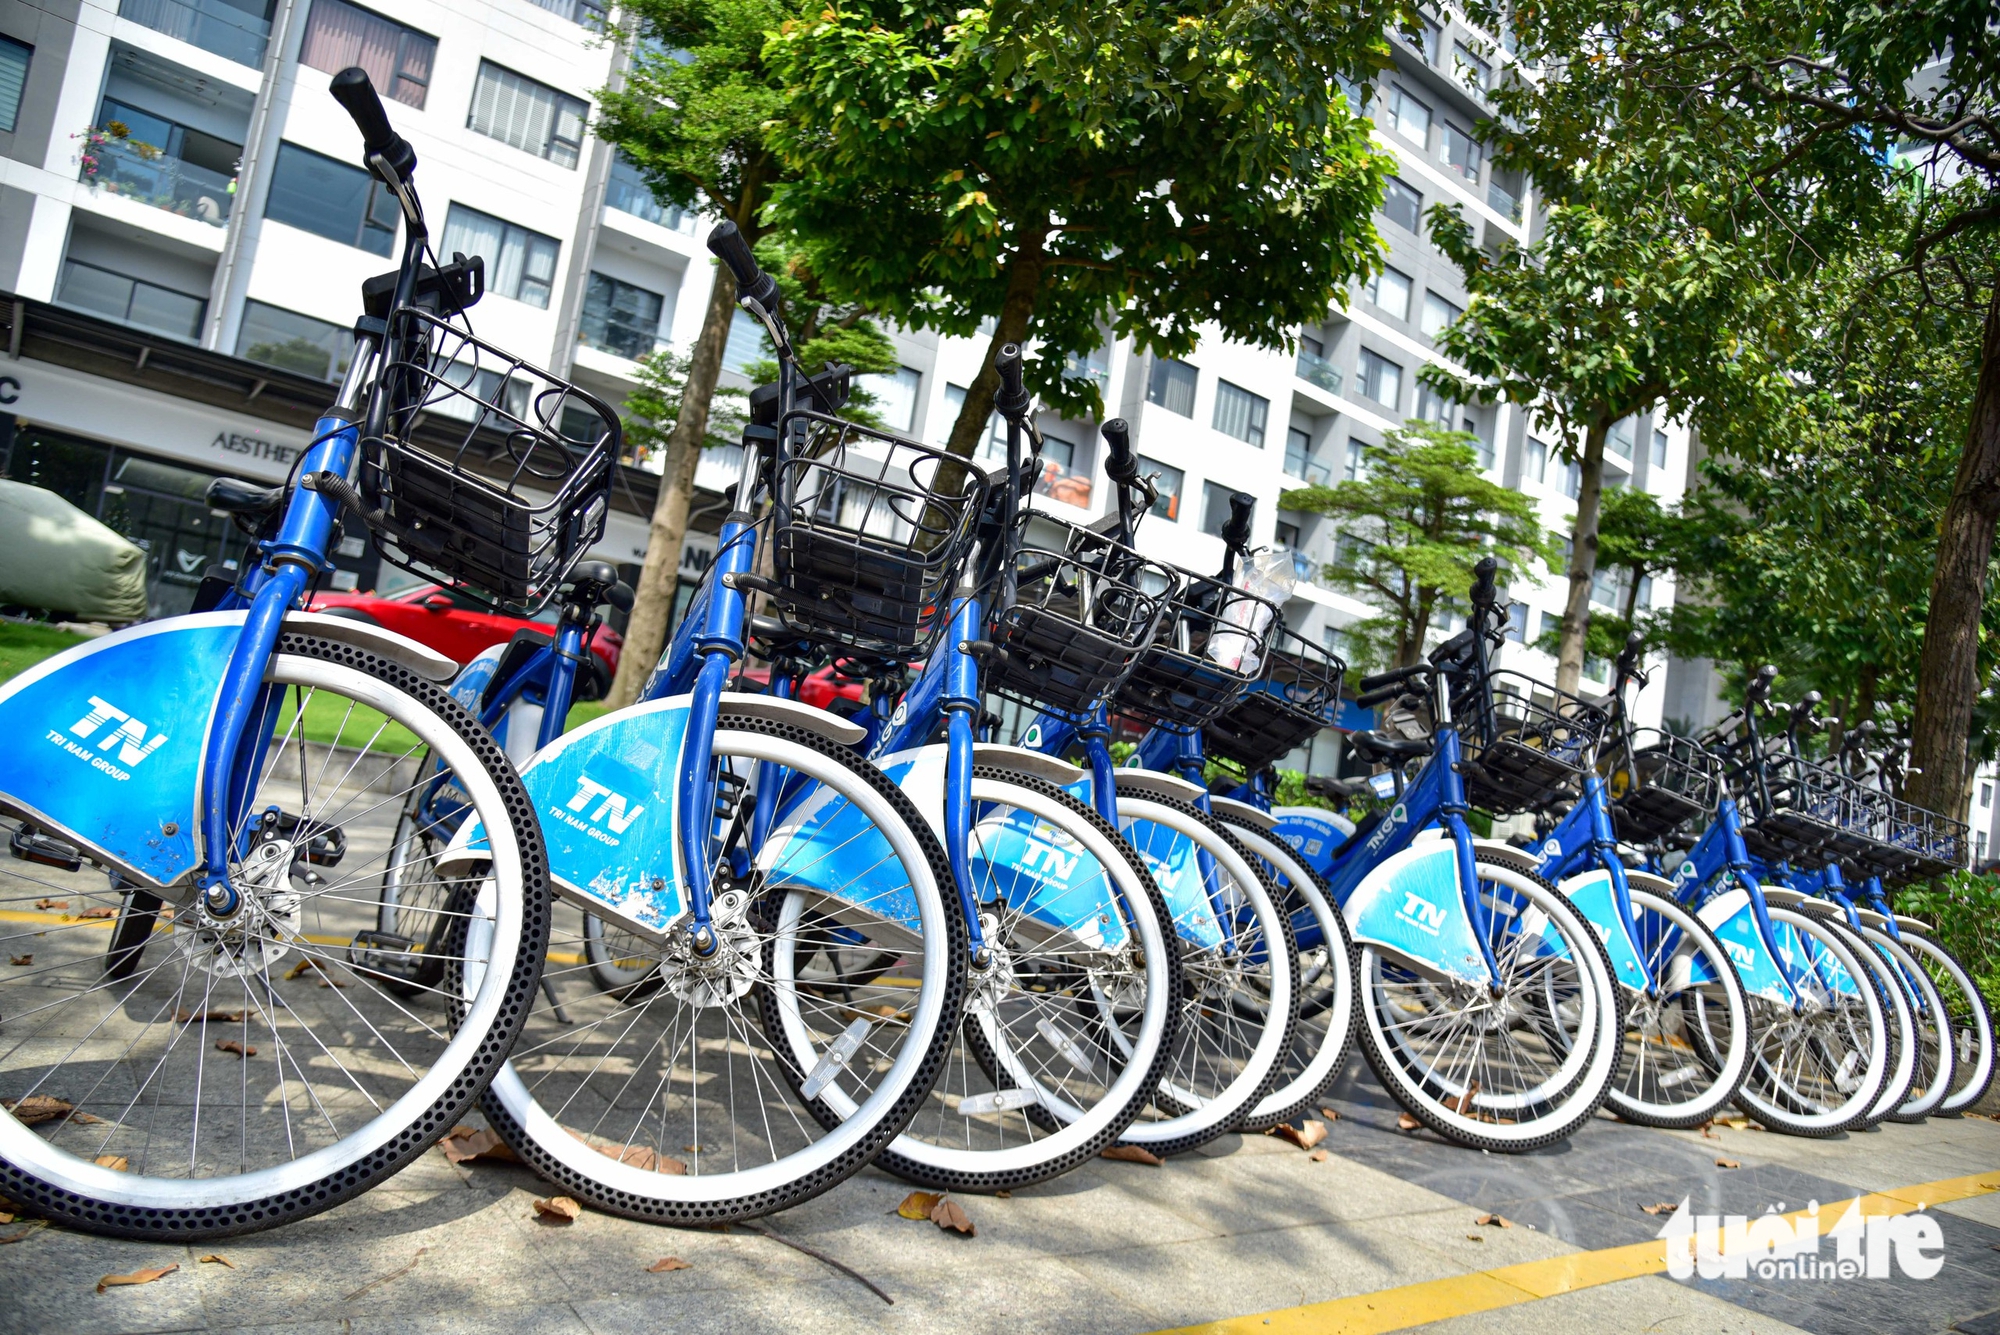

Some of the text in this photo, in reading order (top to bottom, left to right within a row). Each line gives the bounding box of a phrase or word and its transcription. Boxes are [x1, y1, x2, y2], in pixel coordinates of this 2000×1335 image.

[46, 729, 131, 781] TRI NAM GROUP
[69, 695, 168, 767] TN
[548, 805, 620, 847] TRI NAM GROUP
[566, 775, 645, 834] TN
[1021, 837, 1079, 881] TN
[1403, 891, 1448, 929] TN
